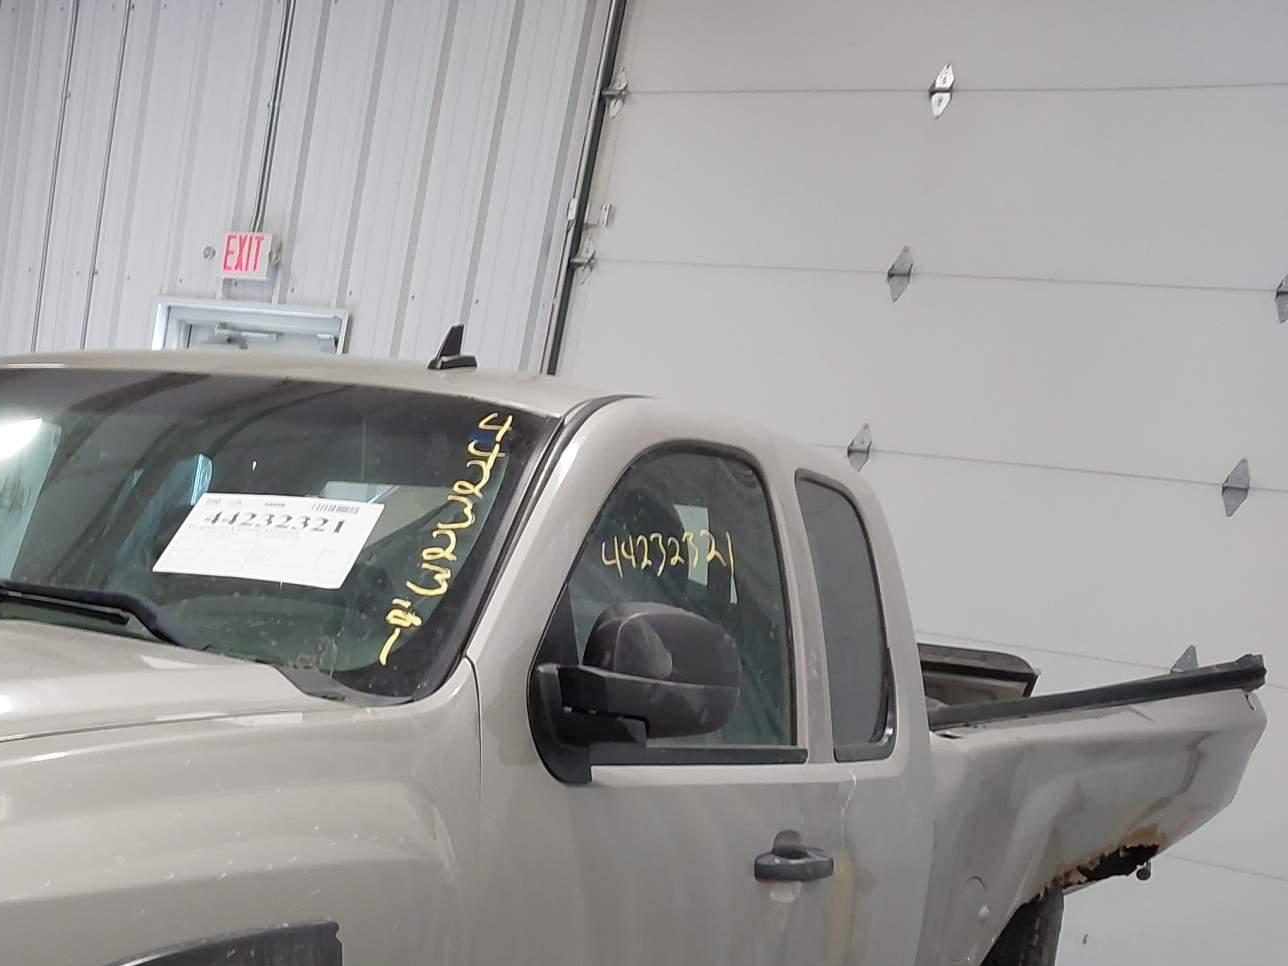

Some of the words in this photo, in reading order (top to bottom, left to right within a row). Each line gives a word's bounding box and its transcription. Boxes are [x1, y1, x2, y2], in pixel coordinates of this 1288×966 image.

[222, 233, 265, 273] EXIT
[204, 510, 345, 534] 44232321
[601, 528, 735, 580] 44232321
